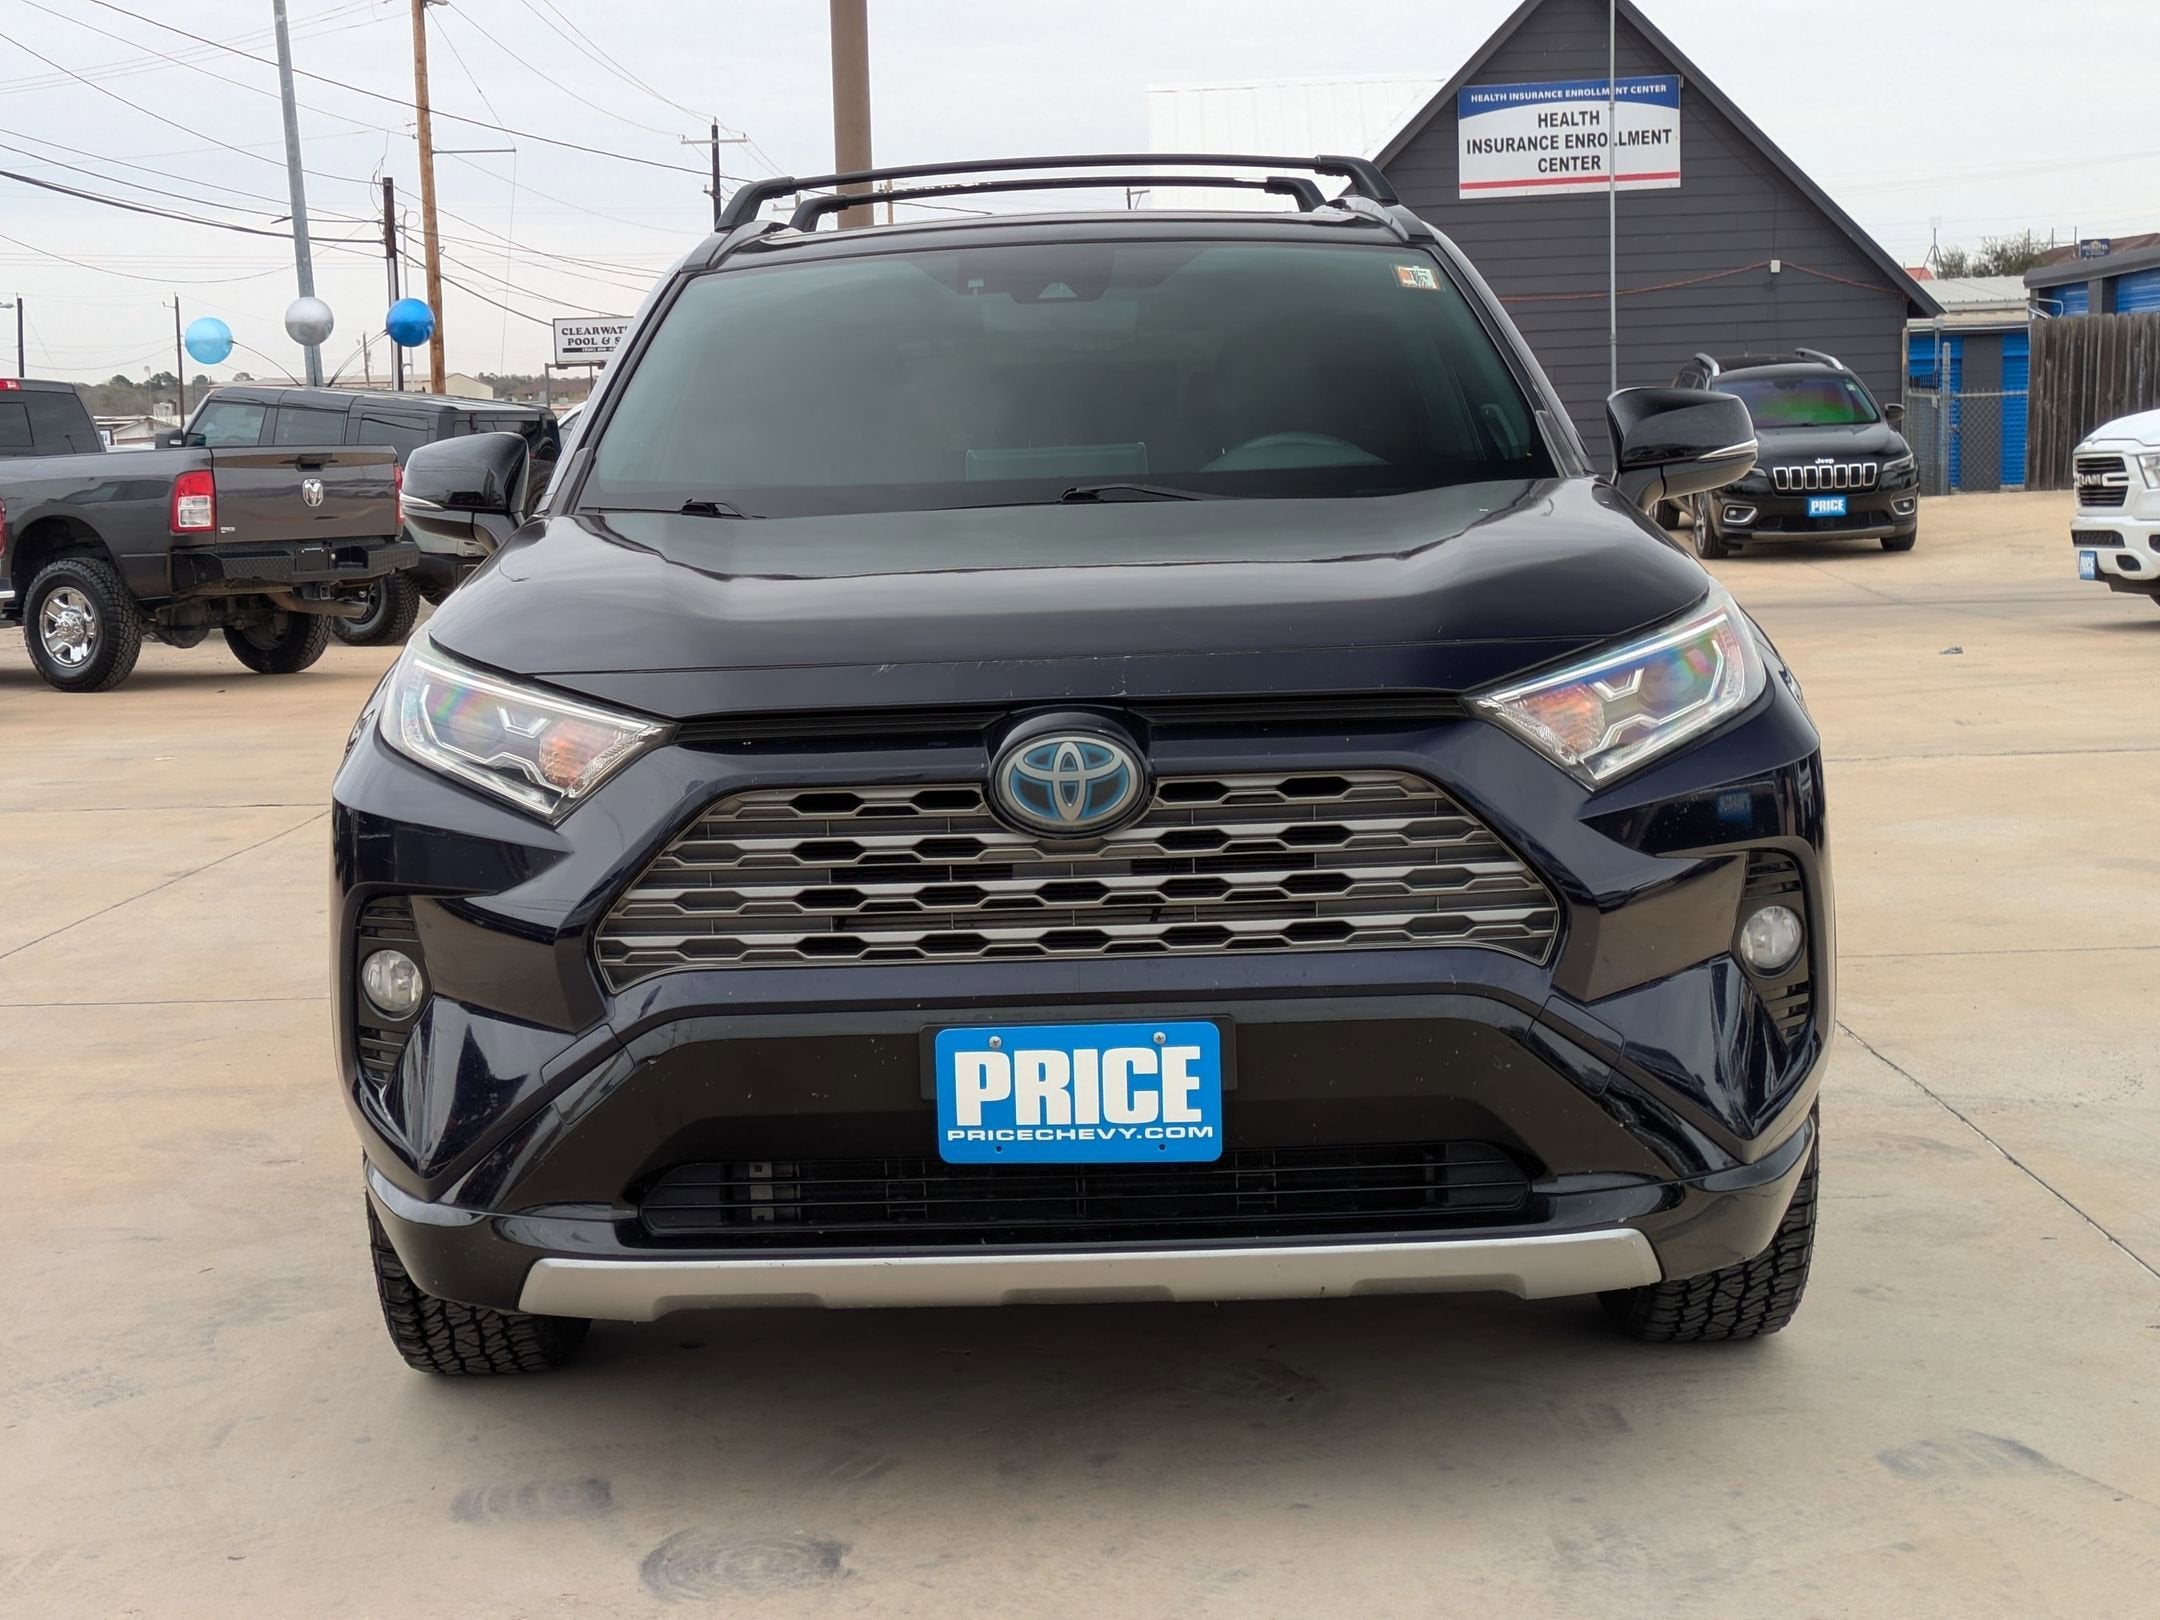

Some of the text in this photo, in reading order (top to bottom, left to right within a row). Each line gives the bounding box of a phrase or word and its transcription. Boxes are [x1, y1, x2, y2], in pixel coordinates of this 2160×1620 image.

[1470, 84, 1667, 103] HEALTH INSURANCE ENROLLMNT CENTER
[1537, 110, 1600, 128] HEALTH
[1466, 128, 1672, 155] INSURANCE ENROLMENT
[1537, 155, 1601, 173] CENTER
[561, 326, 628, 335] CLEARWAT
[567, 338, 598, 346] POOL
[601, 337, 611, 345] &
[1811, 500, 1844, 512] PRICE
[954, 1046, 1202, 1126] PRICE
[947, 1126, 1214, 1142] PRICECHEVY.COM
